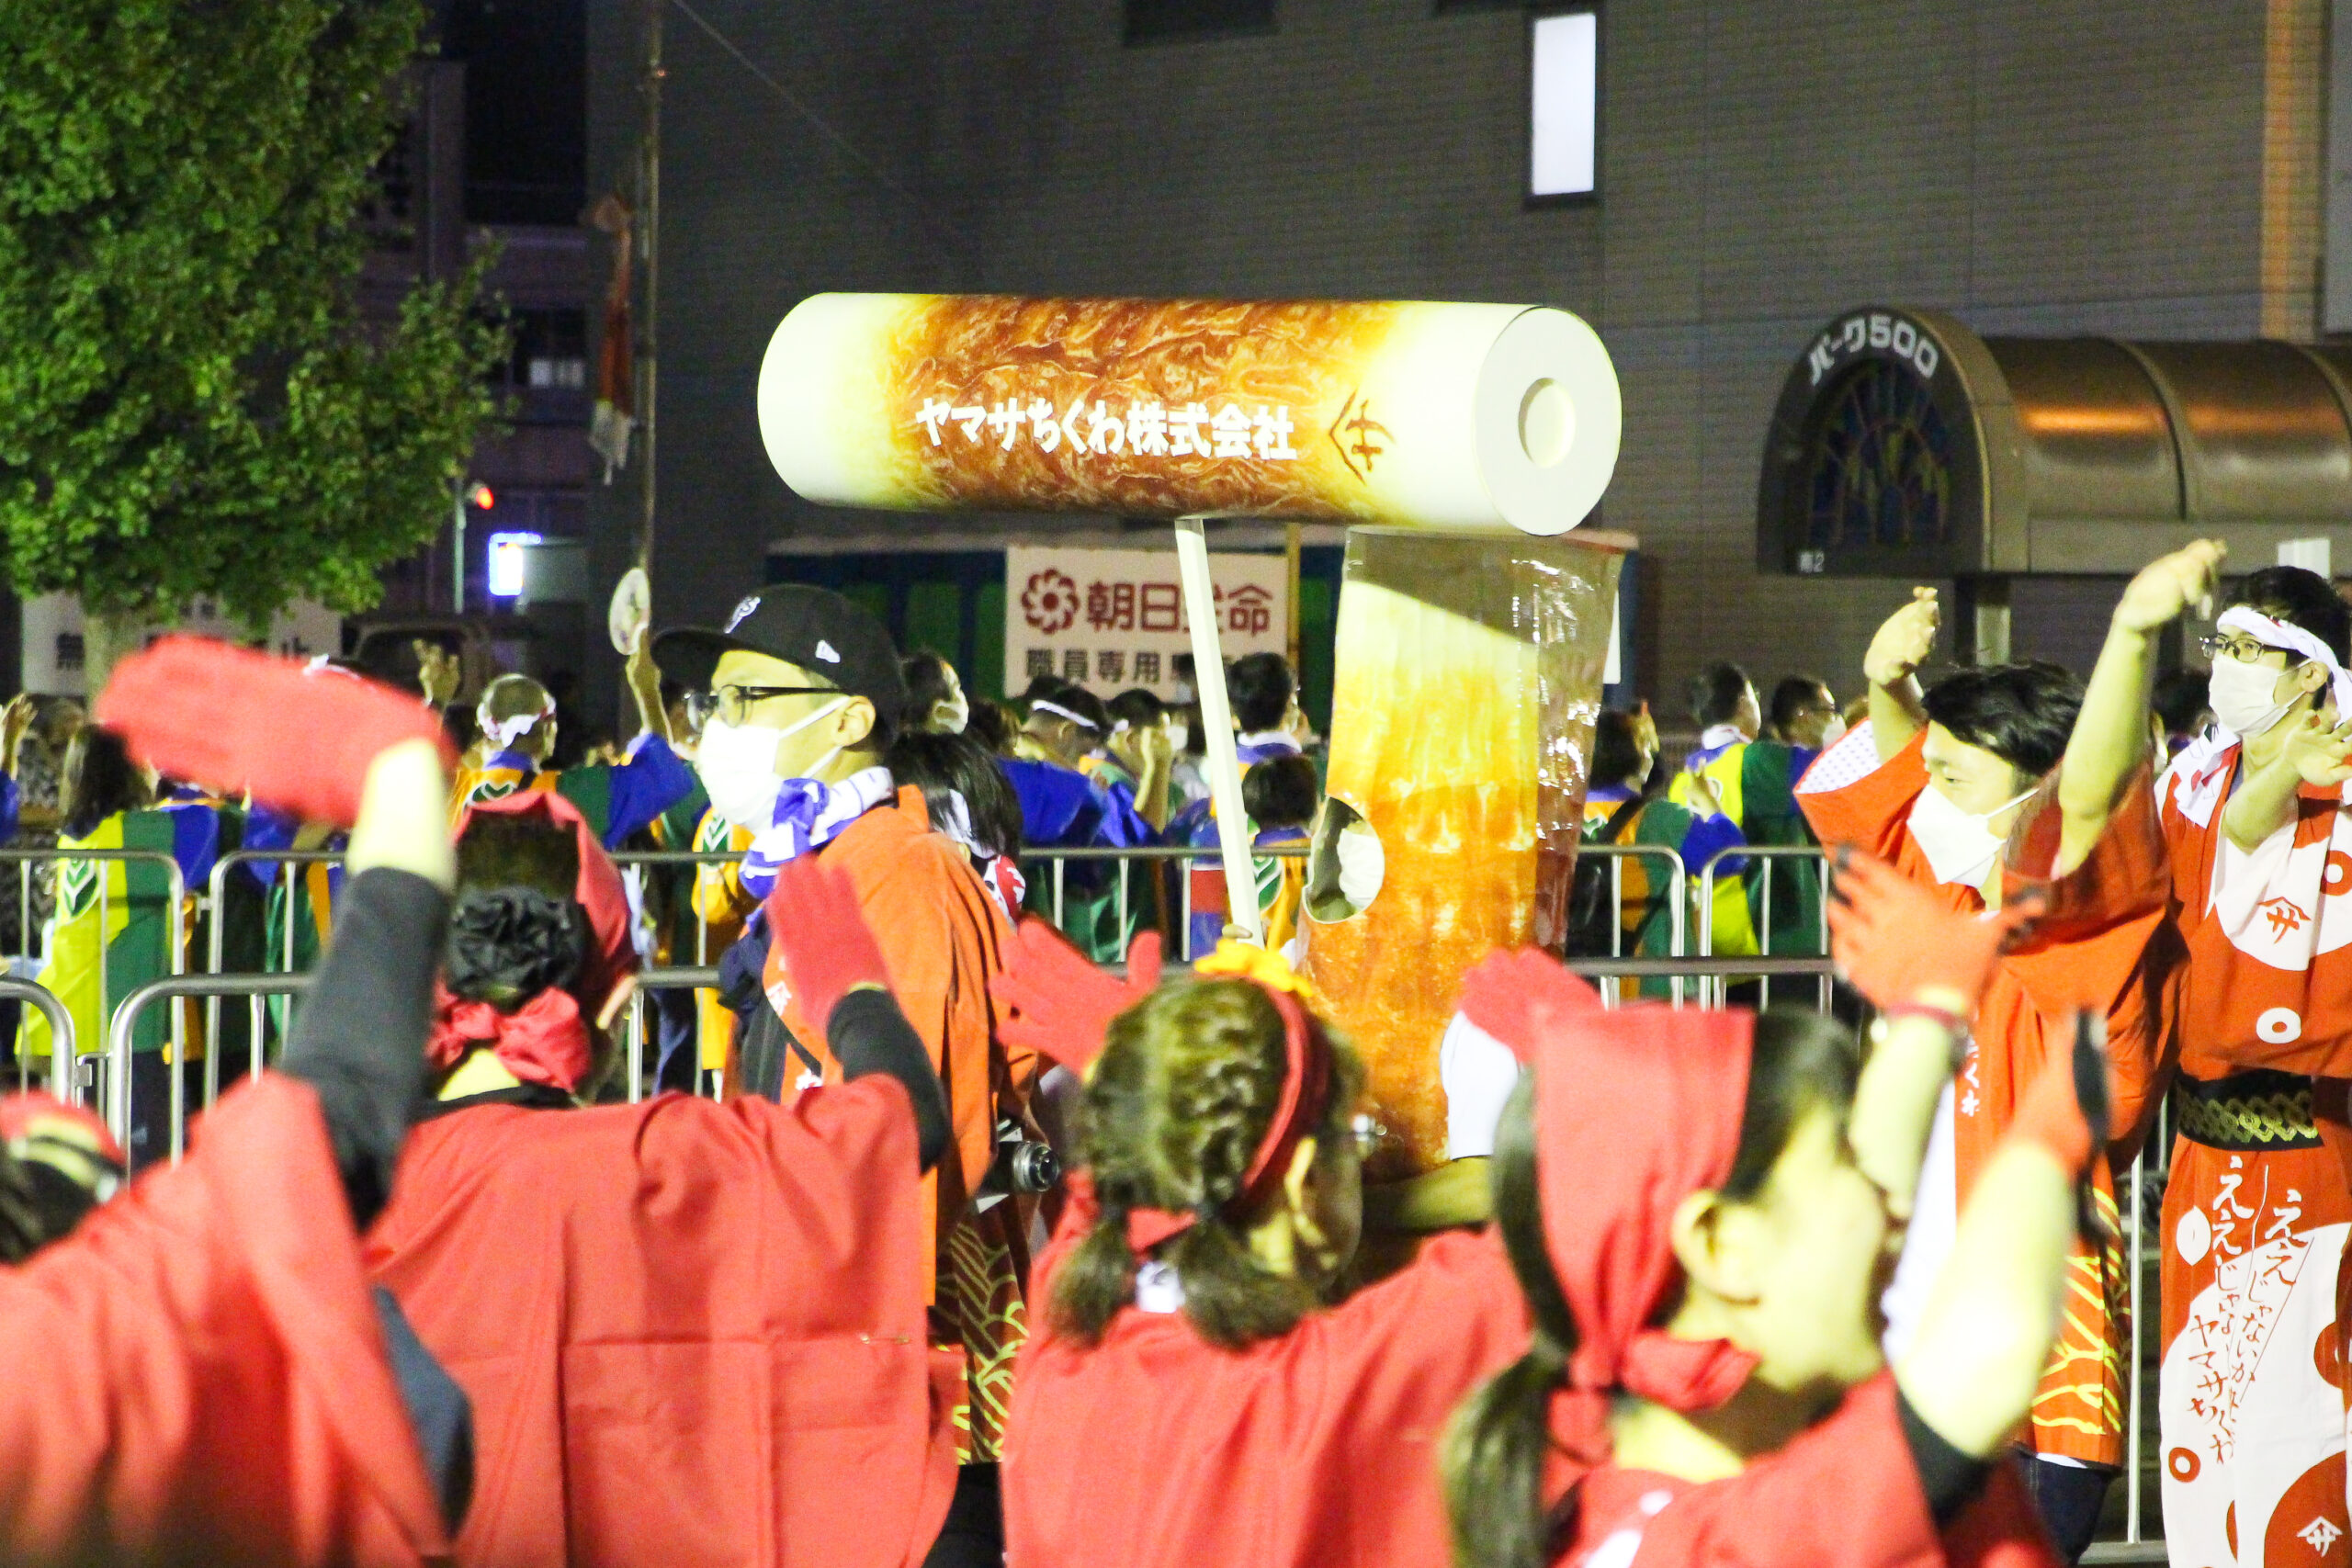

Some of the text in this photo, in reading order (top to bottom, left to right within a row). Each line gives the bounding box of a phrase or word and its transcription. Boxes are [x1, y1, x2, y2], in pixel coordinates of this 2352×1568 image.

[915, 397, 1297, 460] ヤマサちくわ株式会社
[1026, 649, 1237, 684] 職員専用
